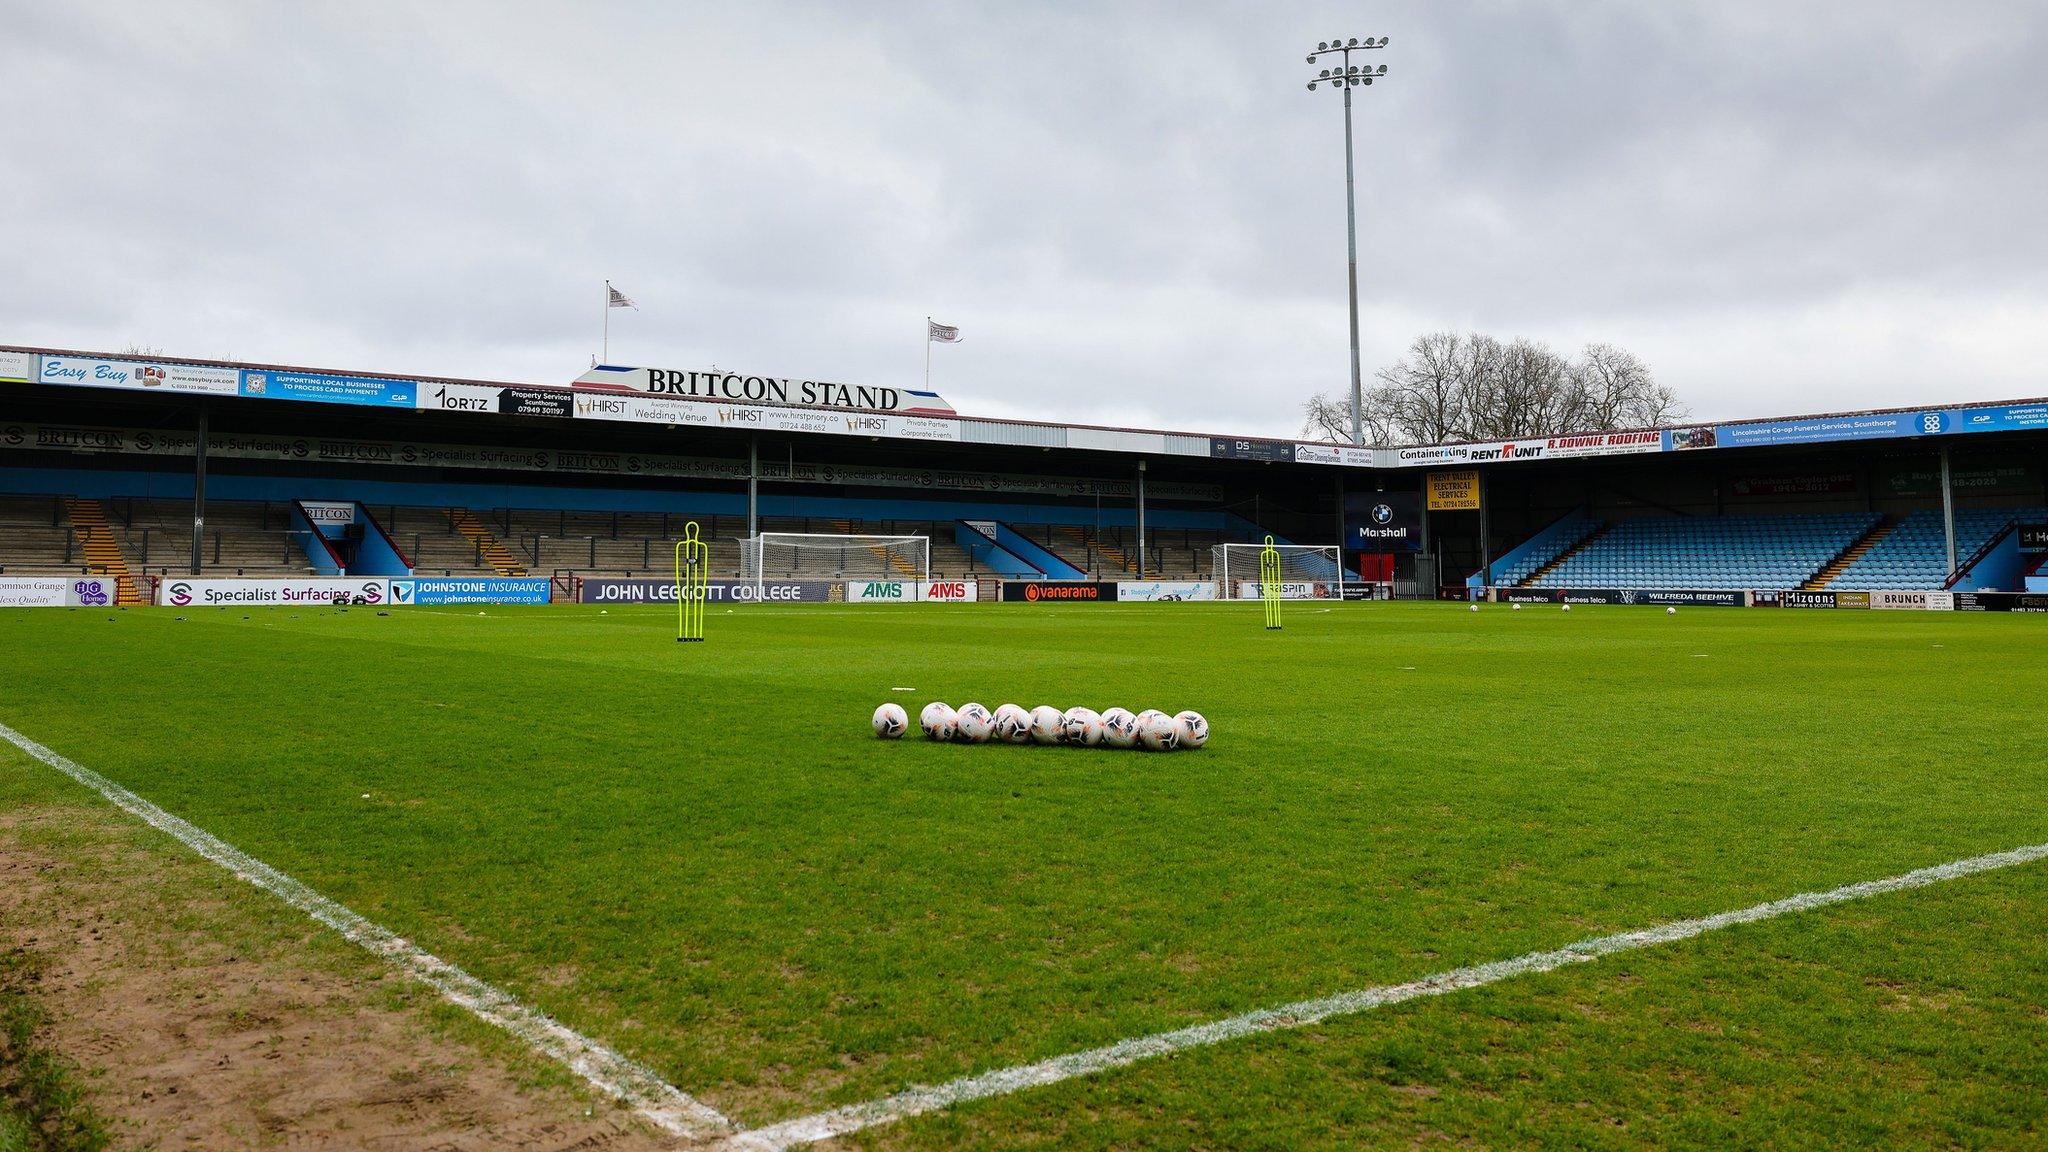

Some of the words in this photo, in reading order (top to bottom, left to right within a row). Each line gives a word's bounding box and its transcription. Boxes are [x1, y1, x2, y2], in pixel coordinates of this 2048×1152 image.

[44, 361, 88, 381] Easy
[95, 364, 128, 384] Buy
[276, 376, 321, 385] SUPPORTING
[346, 381, 386, 390] BUSINESSES
[646, 368, 788, 402] BRITCON
[801, 381, 898, 410] STAND
[511, 391, 541, 400] Property
[543, 392, 571, 401] Services
[518, 405, 540, 413] 07949
[592, 400, 627, 414] HIRST
[671, 403, 693, 411] Winning
[634, 408, 676, 422] Wedding
[678, 412, 708, 422] Venue
[732, 409, 764, 422] HIRST
[779, 422, 798, 430] 01724
[858, 418, 887, 430] HIRST
[36, 430, 124, 446] BRITCON
[901, 428, 932, 438] Corporate
[933, 431, 952, 439] Events
[1608, 432, 1660, 445] ROOFING
[1732, 428, 1771, 436] Lincolnshire
[160, 435, 224, 450] Speciist
[228, 440, 291, 455] Surfacing
[320, 443, 392, 458] BRITCON
[1236, 441, 1250, 450] DS
[422, 448, 476, 461] Specialist
[480, 450, 532, 466] Surfacing
[1470, 450, 1502, 460] RENT
[1515, 447, 1543, 458] UNIT
[557, 454, 620, 468] BRITCON
[644, 458, 691, 470] Specialist
[694, 460, 739, 474] Surfacing
[1434, 482, 1472, 490] ELECTRICAL
[306, 509, 351, 518] RITCON
[1360, 527, 1407, 538] Marshall
[34, 582, 65, 591] Grange
[417, 582, 486, 592] JOHNSTONE
[488, 582, 546, 592] INSURANCE
[596, 585, 644, 599] JOHN
[650, 585, 726, 600] LEGGOTT
[730, 585, 801, 600] COLLEGE
[861, 582, 902, 598] AMS
[928, 583, 965, 598] AMS
[1040, 586, 1098, 599] vanarama
[204, 588, 276, 604] Specialist
[282, 587, 351, 604] Surfacing
[421, 594, 542, 604] www.johnstoneinsurance.co.uk
[1785, 592, 1834, 603] Mizaans
[1885, 594, 1926, 603] BRUNCH
